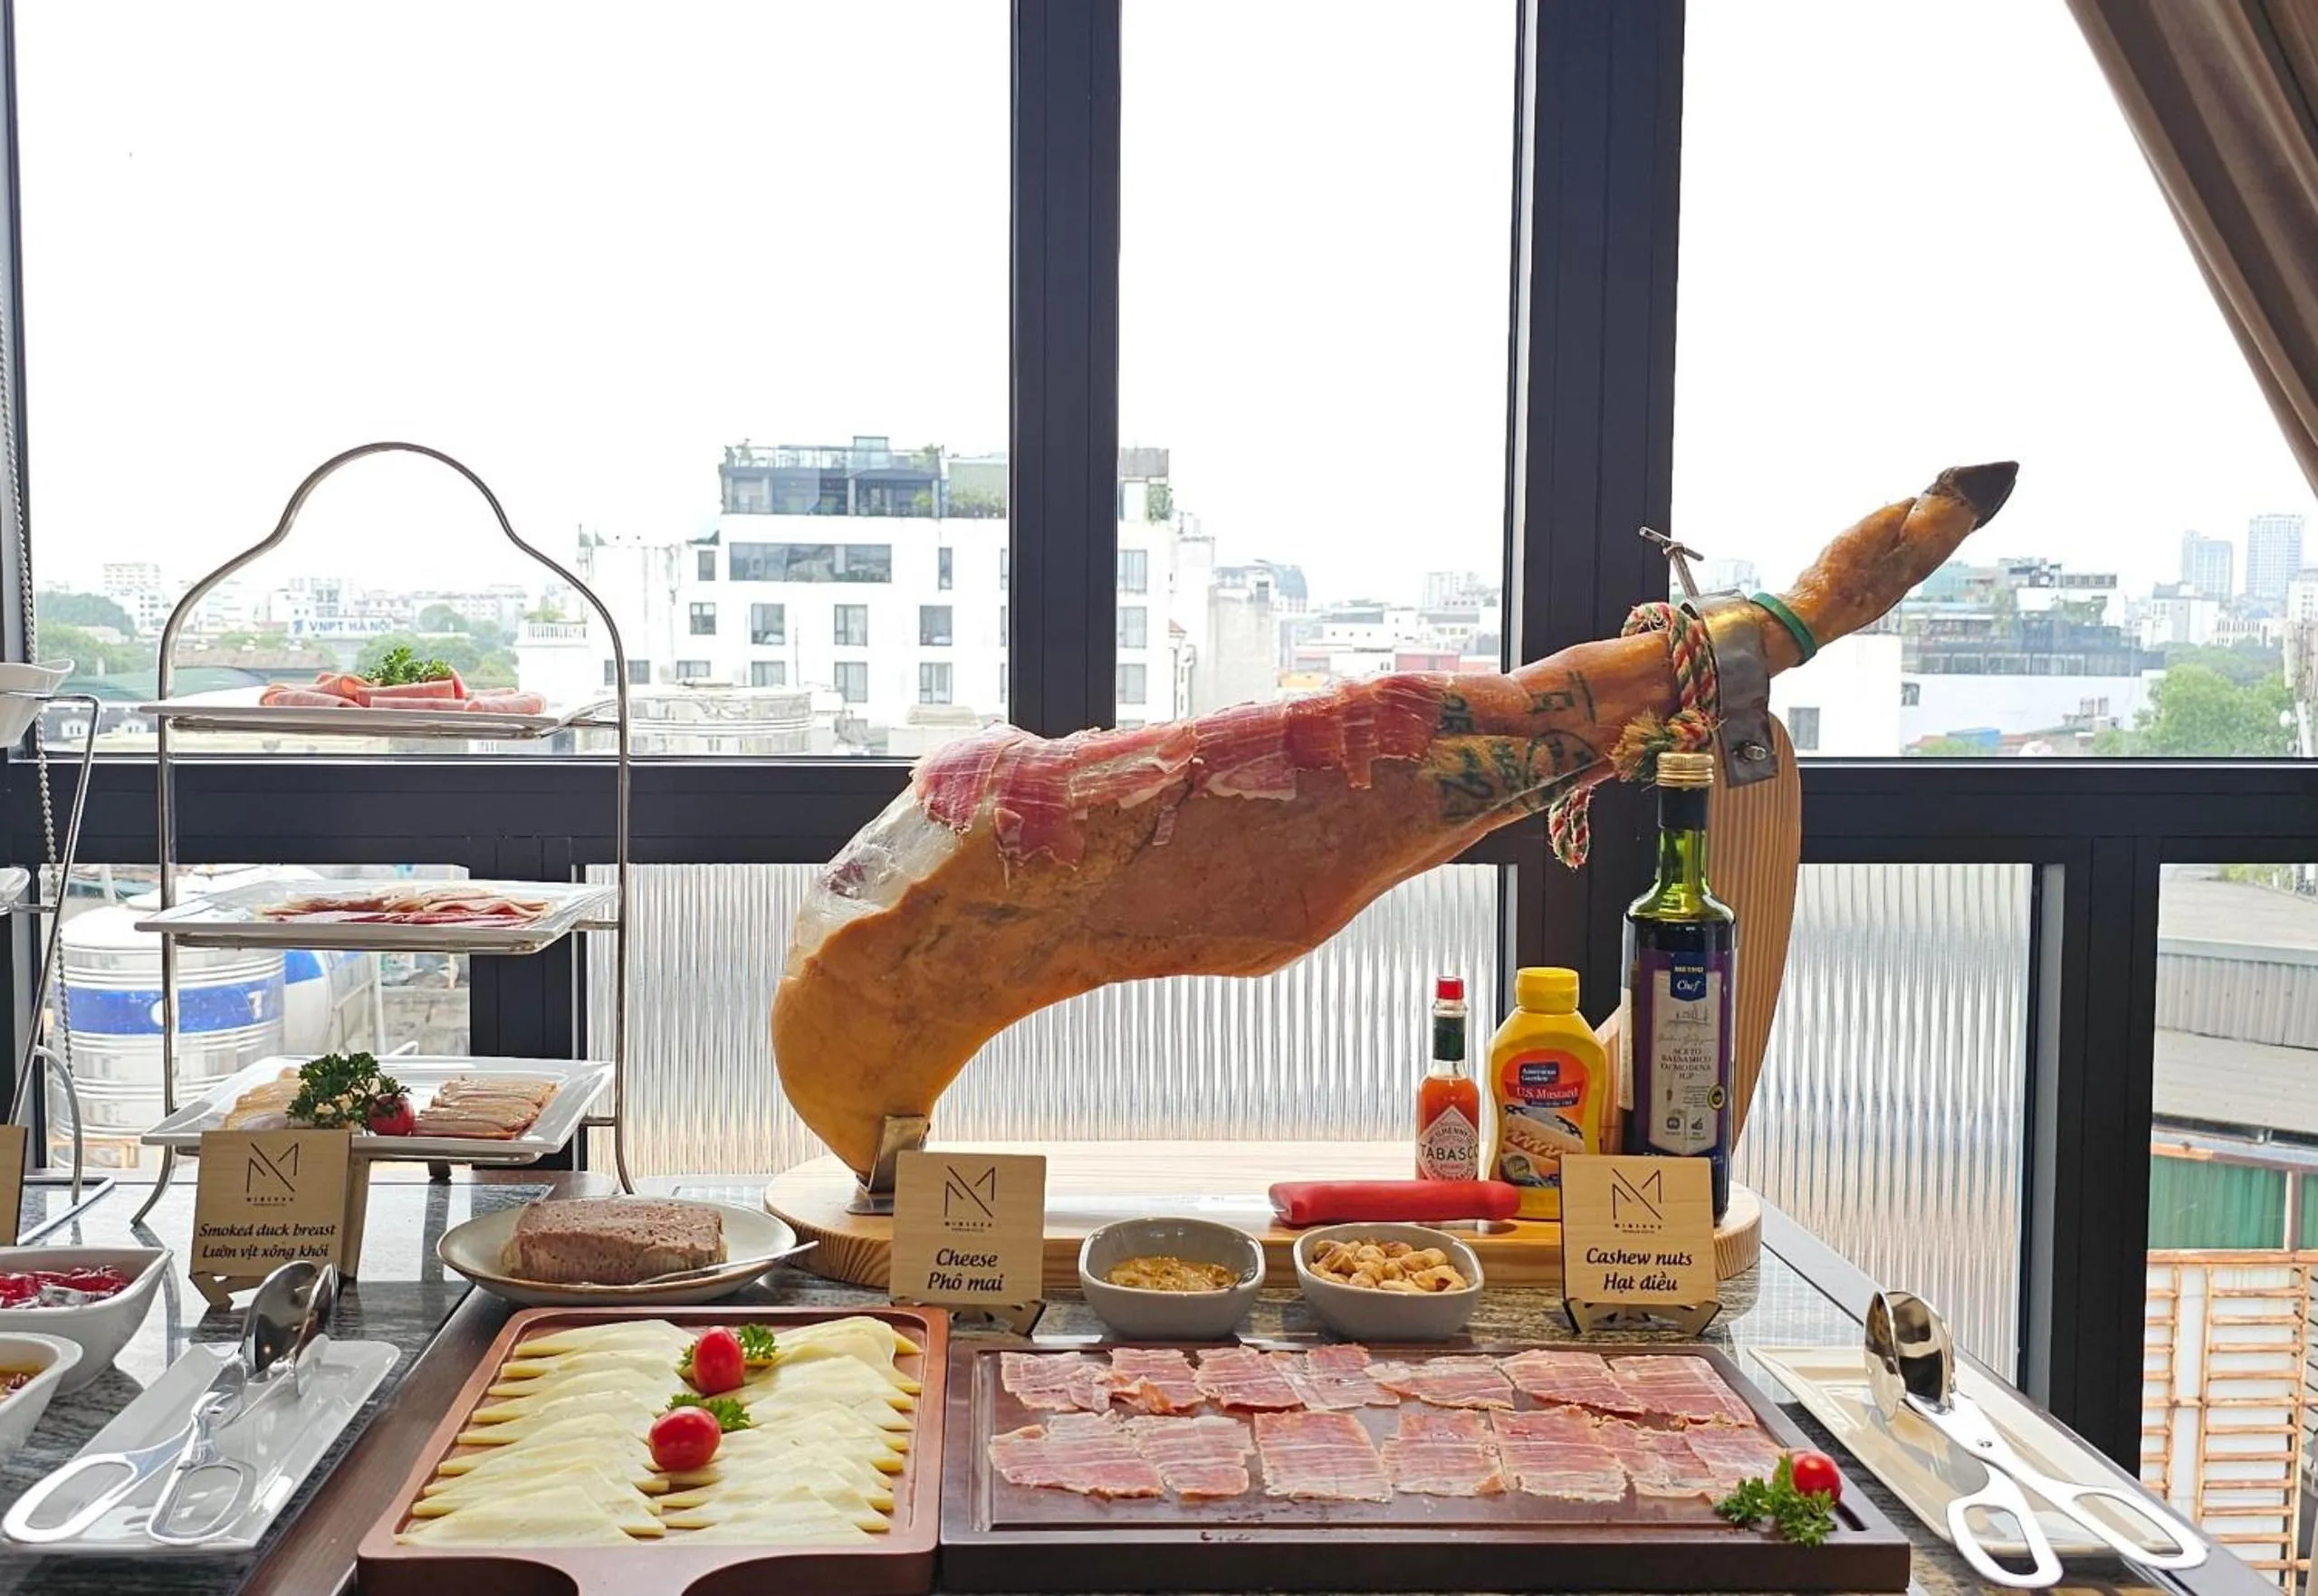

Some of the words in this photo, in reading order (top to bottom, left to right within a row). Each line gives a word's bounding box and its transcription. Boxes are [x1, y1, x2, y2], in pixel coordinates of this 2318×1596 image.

[309, 620, 344, 632] VNPT
[1676, 980, 1701, 992] Chef
[1536, 1085, 1579, 1100] Mustard
[1419, 1143, 1479, 1161] TABASCO
[198, 1223, 254, 1238] Smoked
[255, 1223, 290, 1238] duck
[292, 1223, 336, 1238] breast
[240, 1244, 259, 1260] vịt
[298, 1243, 330, 1257] khói
[935, 1247, 999, 1267] Cheese
[1585, 1247, 1652, 1266] Cashew
[1654, 1250, 1693, 1266] nuts
[926, 1270, 963, 1291] Phô
[966, 1273, 1005, 1292] mai
[1603, 1271, 1635, 1294] Hạt
